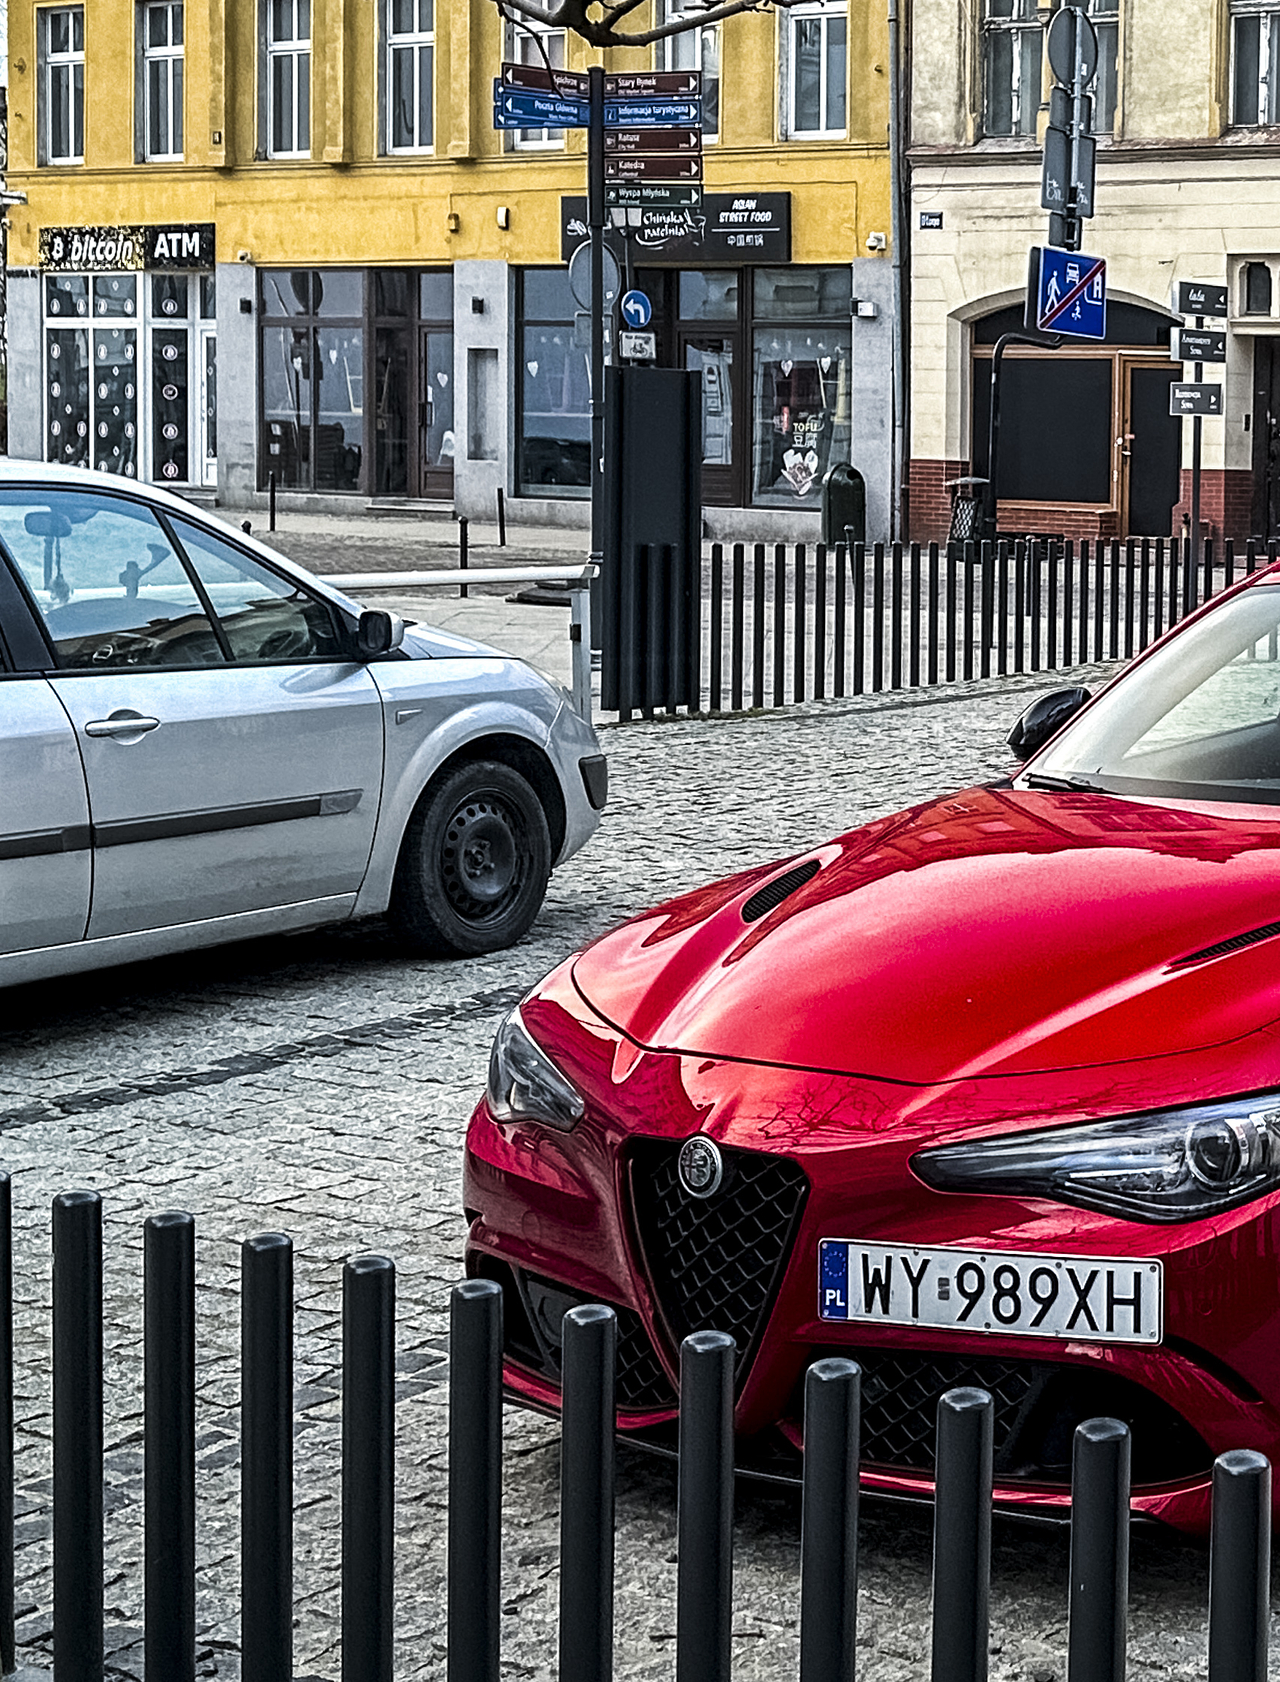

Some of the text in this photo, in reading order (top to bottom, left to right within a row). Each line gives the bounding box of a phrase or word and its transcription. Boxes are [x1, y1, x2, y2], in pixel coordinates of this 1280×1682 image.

[534, 100, 554, 111] Poczta
[732, 199, 758, 210] ASIAN
[719, 211, 772, 223] STREET FOOD
[71, 232, 200, 262] bitcoin ATM
[792, 422, 818, 432] TOFU
[825, 1289, 846, 1307] PL
[860, 1252, 1143, 1334] WY 989XH
